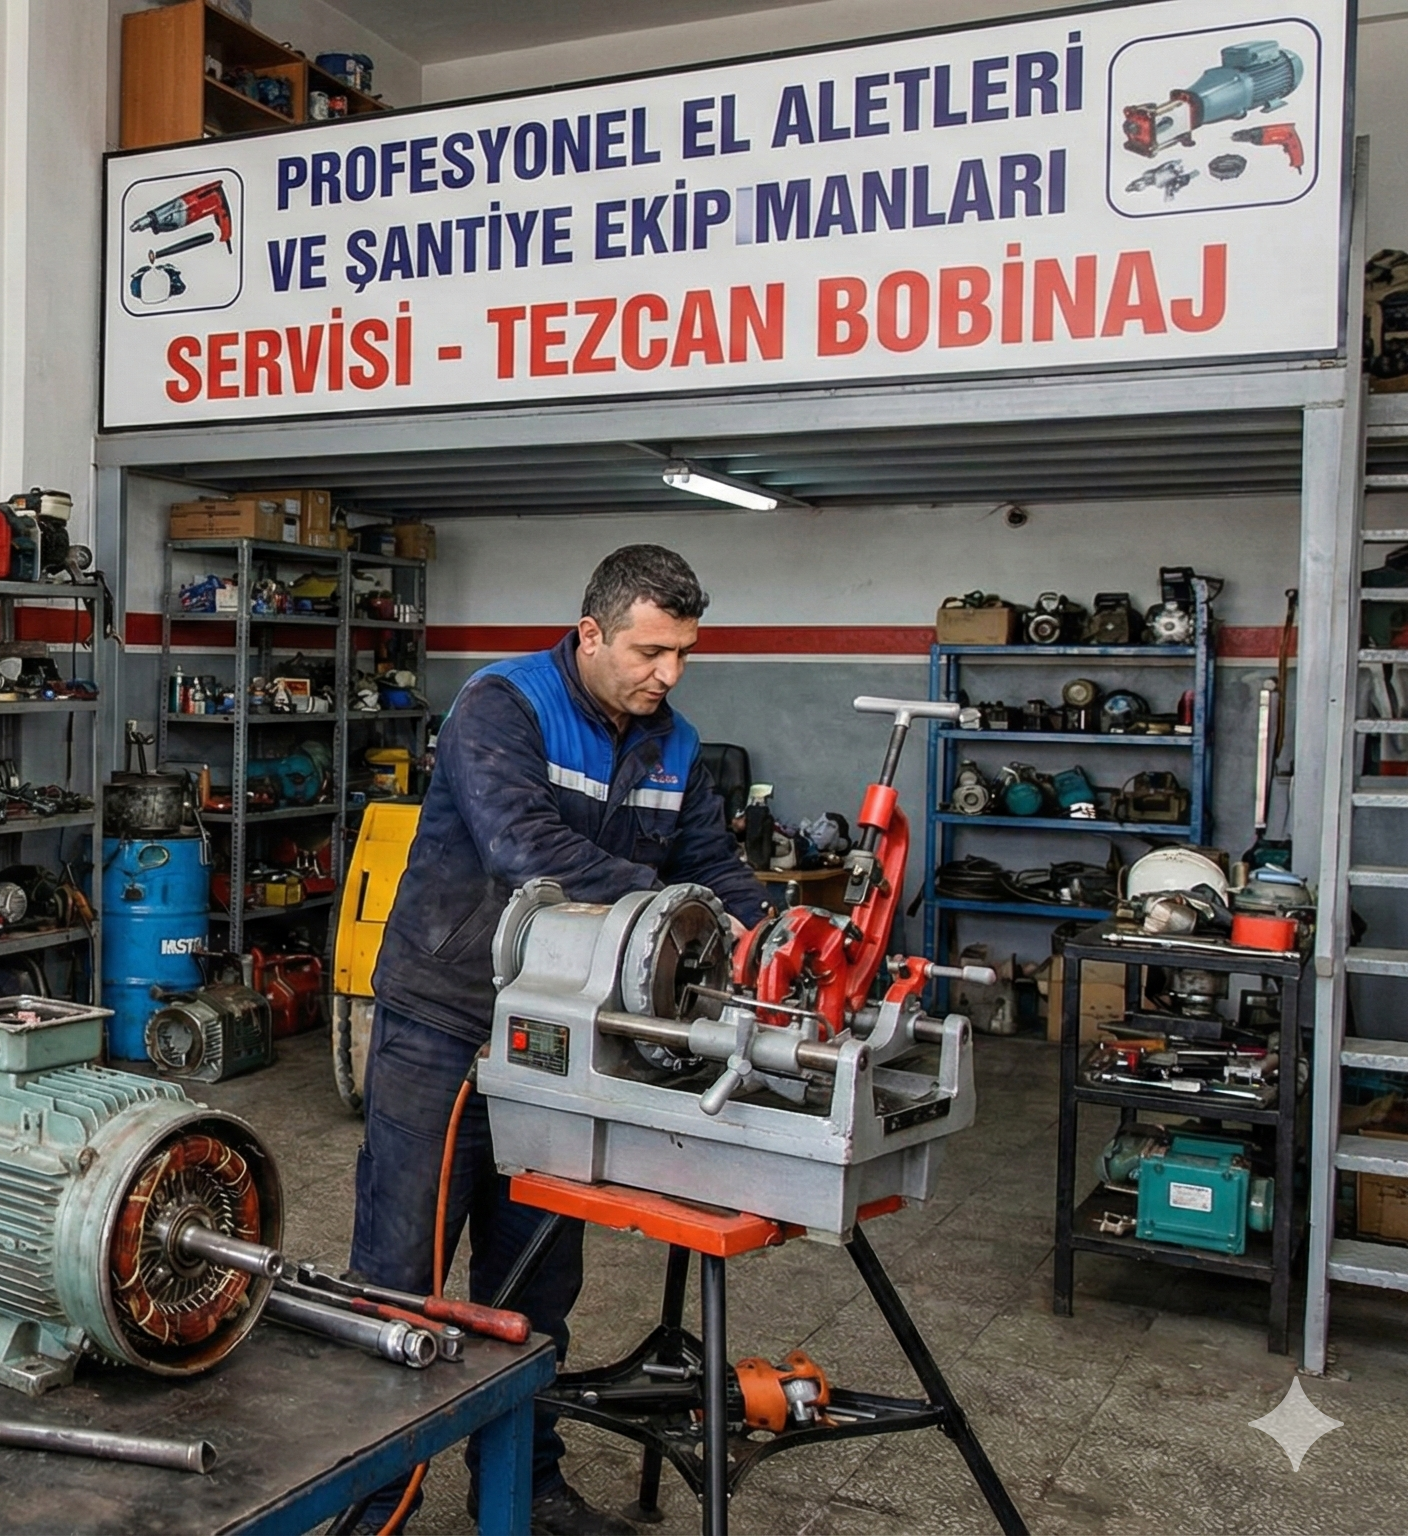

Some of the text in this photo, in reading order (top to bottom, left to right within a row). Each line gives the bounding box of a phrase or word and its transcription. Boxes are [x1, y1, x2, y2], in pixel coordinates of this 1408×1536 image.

[277, 30, 1084, 210] PROFESYONEL EL ALETLERİ
[166, 301, 412, 402] SERVİSİ
[487, 282, 785, 379] TEZCAN
[817, 243, 1227, 357] BOBİNAJ
[267, 234, 327, 292] VE
[345, 200, 573, 292] ŞANTİYE
